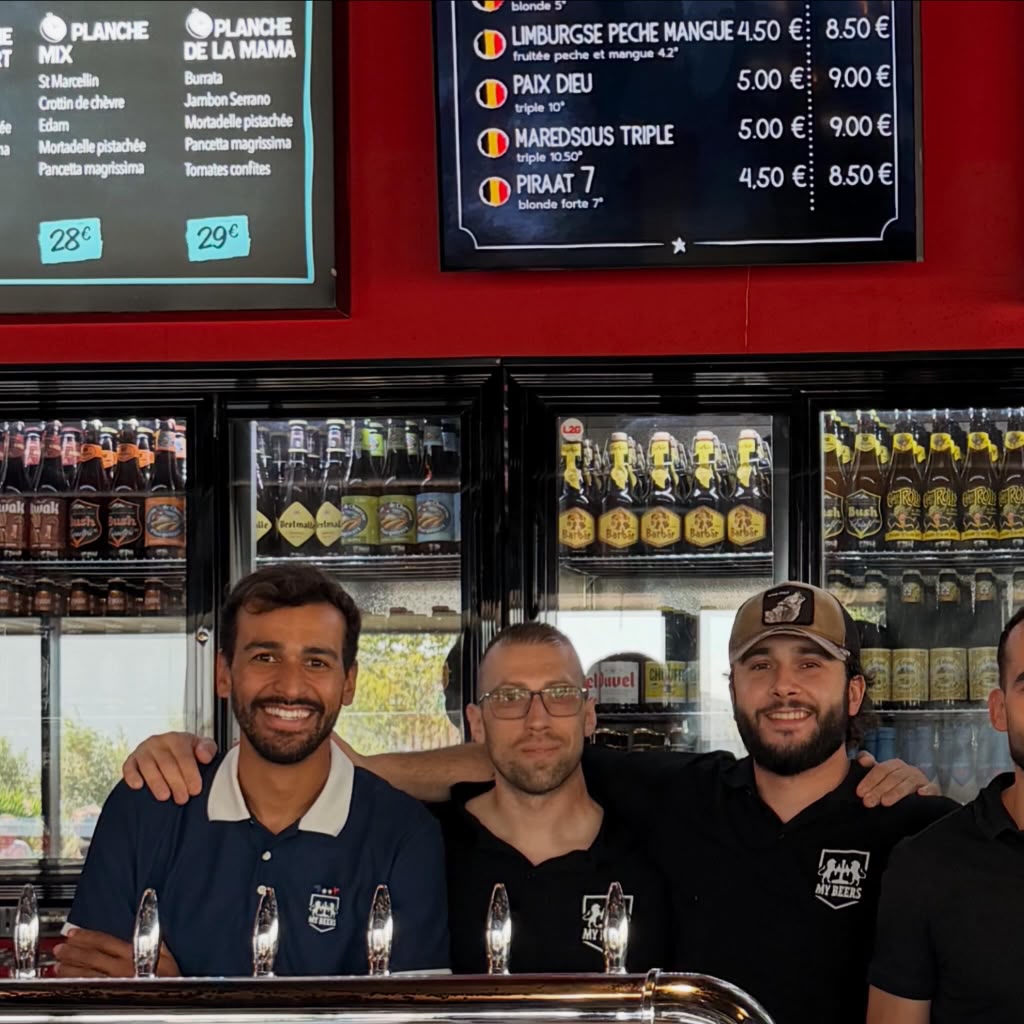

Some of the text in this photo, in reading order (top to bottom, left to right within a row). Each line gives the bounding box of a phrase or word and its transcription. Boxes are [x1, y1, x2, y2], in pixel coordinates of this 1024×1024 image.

[511, 1, 551, 12] blonde
[71, 21, 149, 41] PLANCHE
[214, 17, 292, 37] PLANCHE
[512, 24, 603, 46] LIMBURGSE
[608, 22, 660, 44] PECHE
[663, 20, 735, 42] MANGUE
[737, 20, 781, 41] 4.50
[825, 18, 871, 39] 8.50
[38, 46, 73, 64] MIX
[184, 39, 296, 61] DE LA MAMA
[513, 50, 550, 61] fruitée
[554, 50, 589, 63] peche
[593, 49, 605, 60] et
[608, 49, 655, 62] mangue
[38, 73, 99, 88] St Marcellin
[184, 71, 223, 86] Burrata
[513, 74, 551, 95] PAIX
[555, 73, 593, 93] DIEU
[736, 70, 782, 91] 5.00
[828, 67, 873, 89] 9.00
[38, 95, 125, 110] Crottin de chèvre
[184, 92, 271, 108] Jambon Serrano
[514, 102, 546, 115] triple
[38, 118, 69, 132] Edam
[184, 113, 294, 131] Mortadelle pistachée
[515, 127, 615, 148] MAREDSOUS
[620, 125, 675, 146] TRIPLE
[738, 118, 783, 140] 5.00
[829, 116, 874, 137] 9.00
[38, 139, 146, 156] Mortadelle pistachée
[184, 136, 292, 153] Pancetta magrissima
[516, 152, 547, 165] triple
[38, 161, 145, 179] Pancetta magrissima
[184, 161, 271, 177] Tomates confites
[516, 173, 575, 195] PIRAAT
[580, 166, 596, 193] 7
[828, 165, 874, 187] 8.50
[518, 199, 557, 211] blonde
[561, 198, 590, 210] forte
[49, 226, 92, 252] 28€
[196, 224, 239, 250] 29€
[815, 883, 862, 899] MY BEERS
